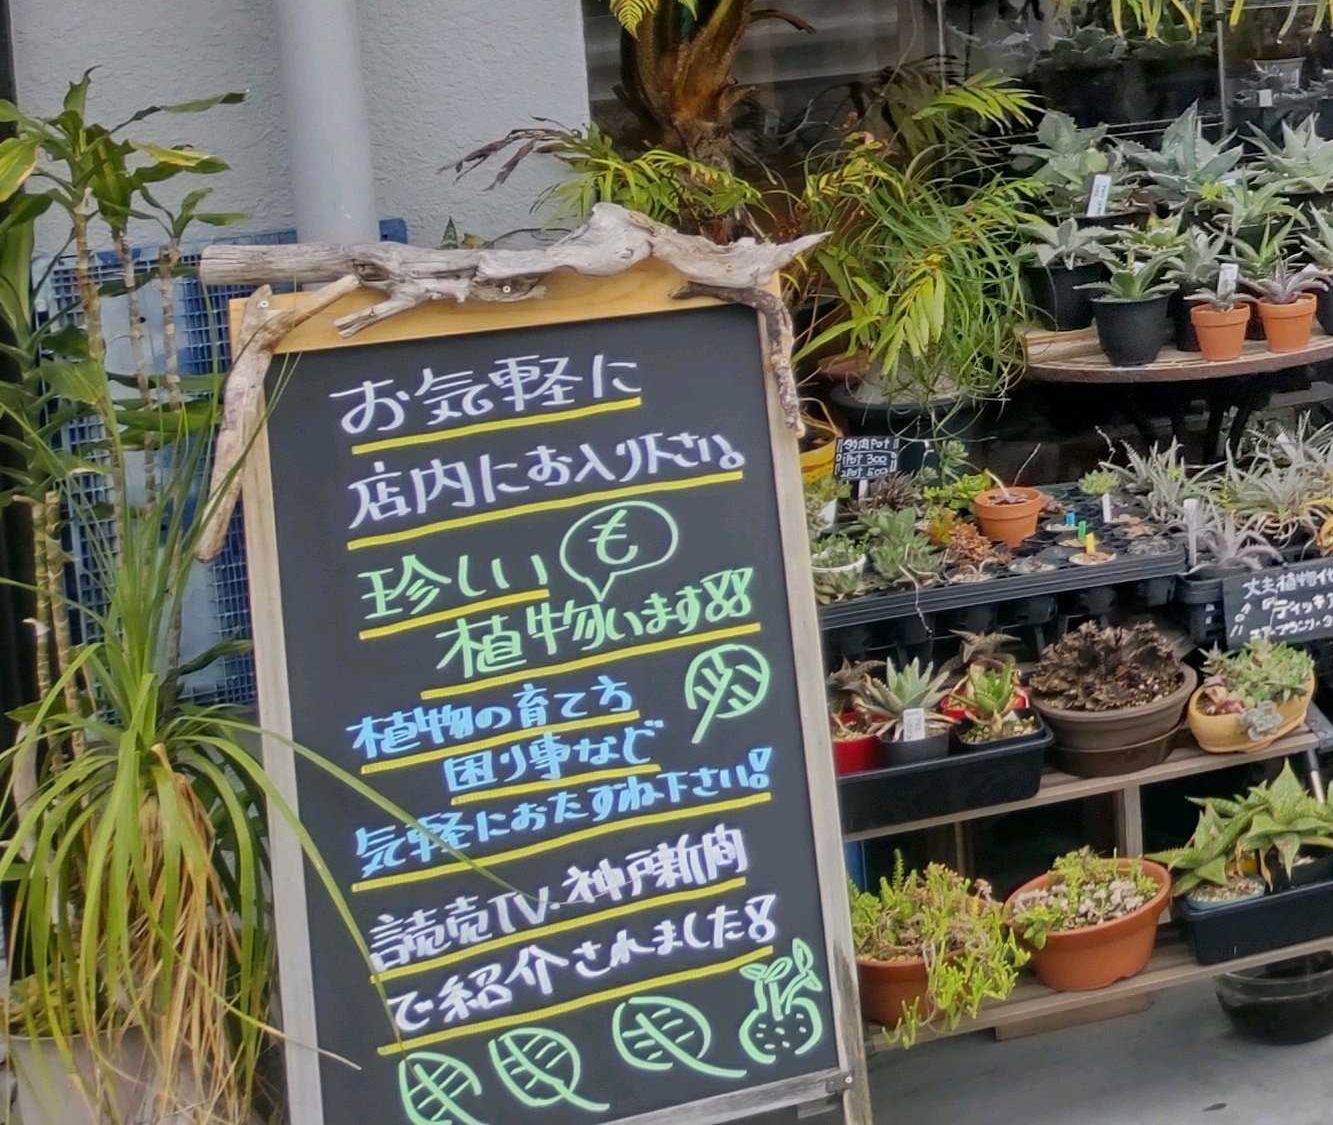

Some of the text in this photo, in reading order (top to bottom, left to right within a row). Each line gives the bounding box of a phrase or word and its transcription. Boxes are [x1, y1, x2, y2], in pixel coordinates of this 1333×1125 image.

[329, 353, 643, 437] お気軽に
[866, 454, 888, 465] 300
[588, 508, 638, 566] も
[356, 554, 550, 622] 珍しい
[346, 675, 634, 761] 植物の育て方
[443, 718, 666, 794] 困り事など
